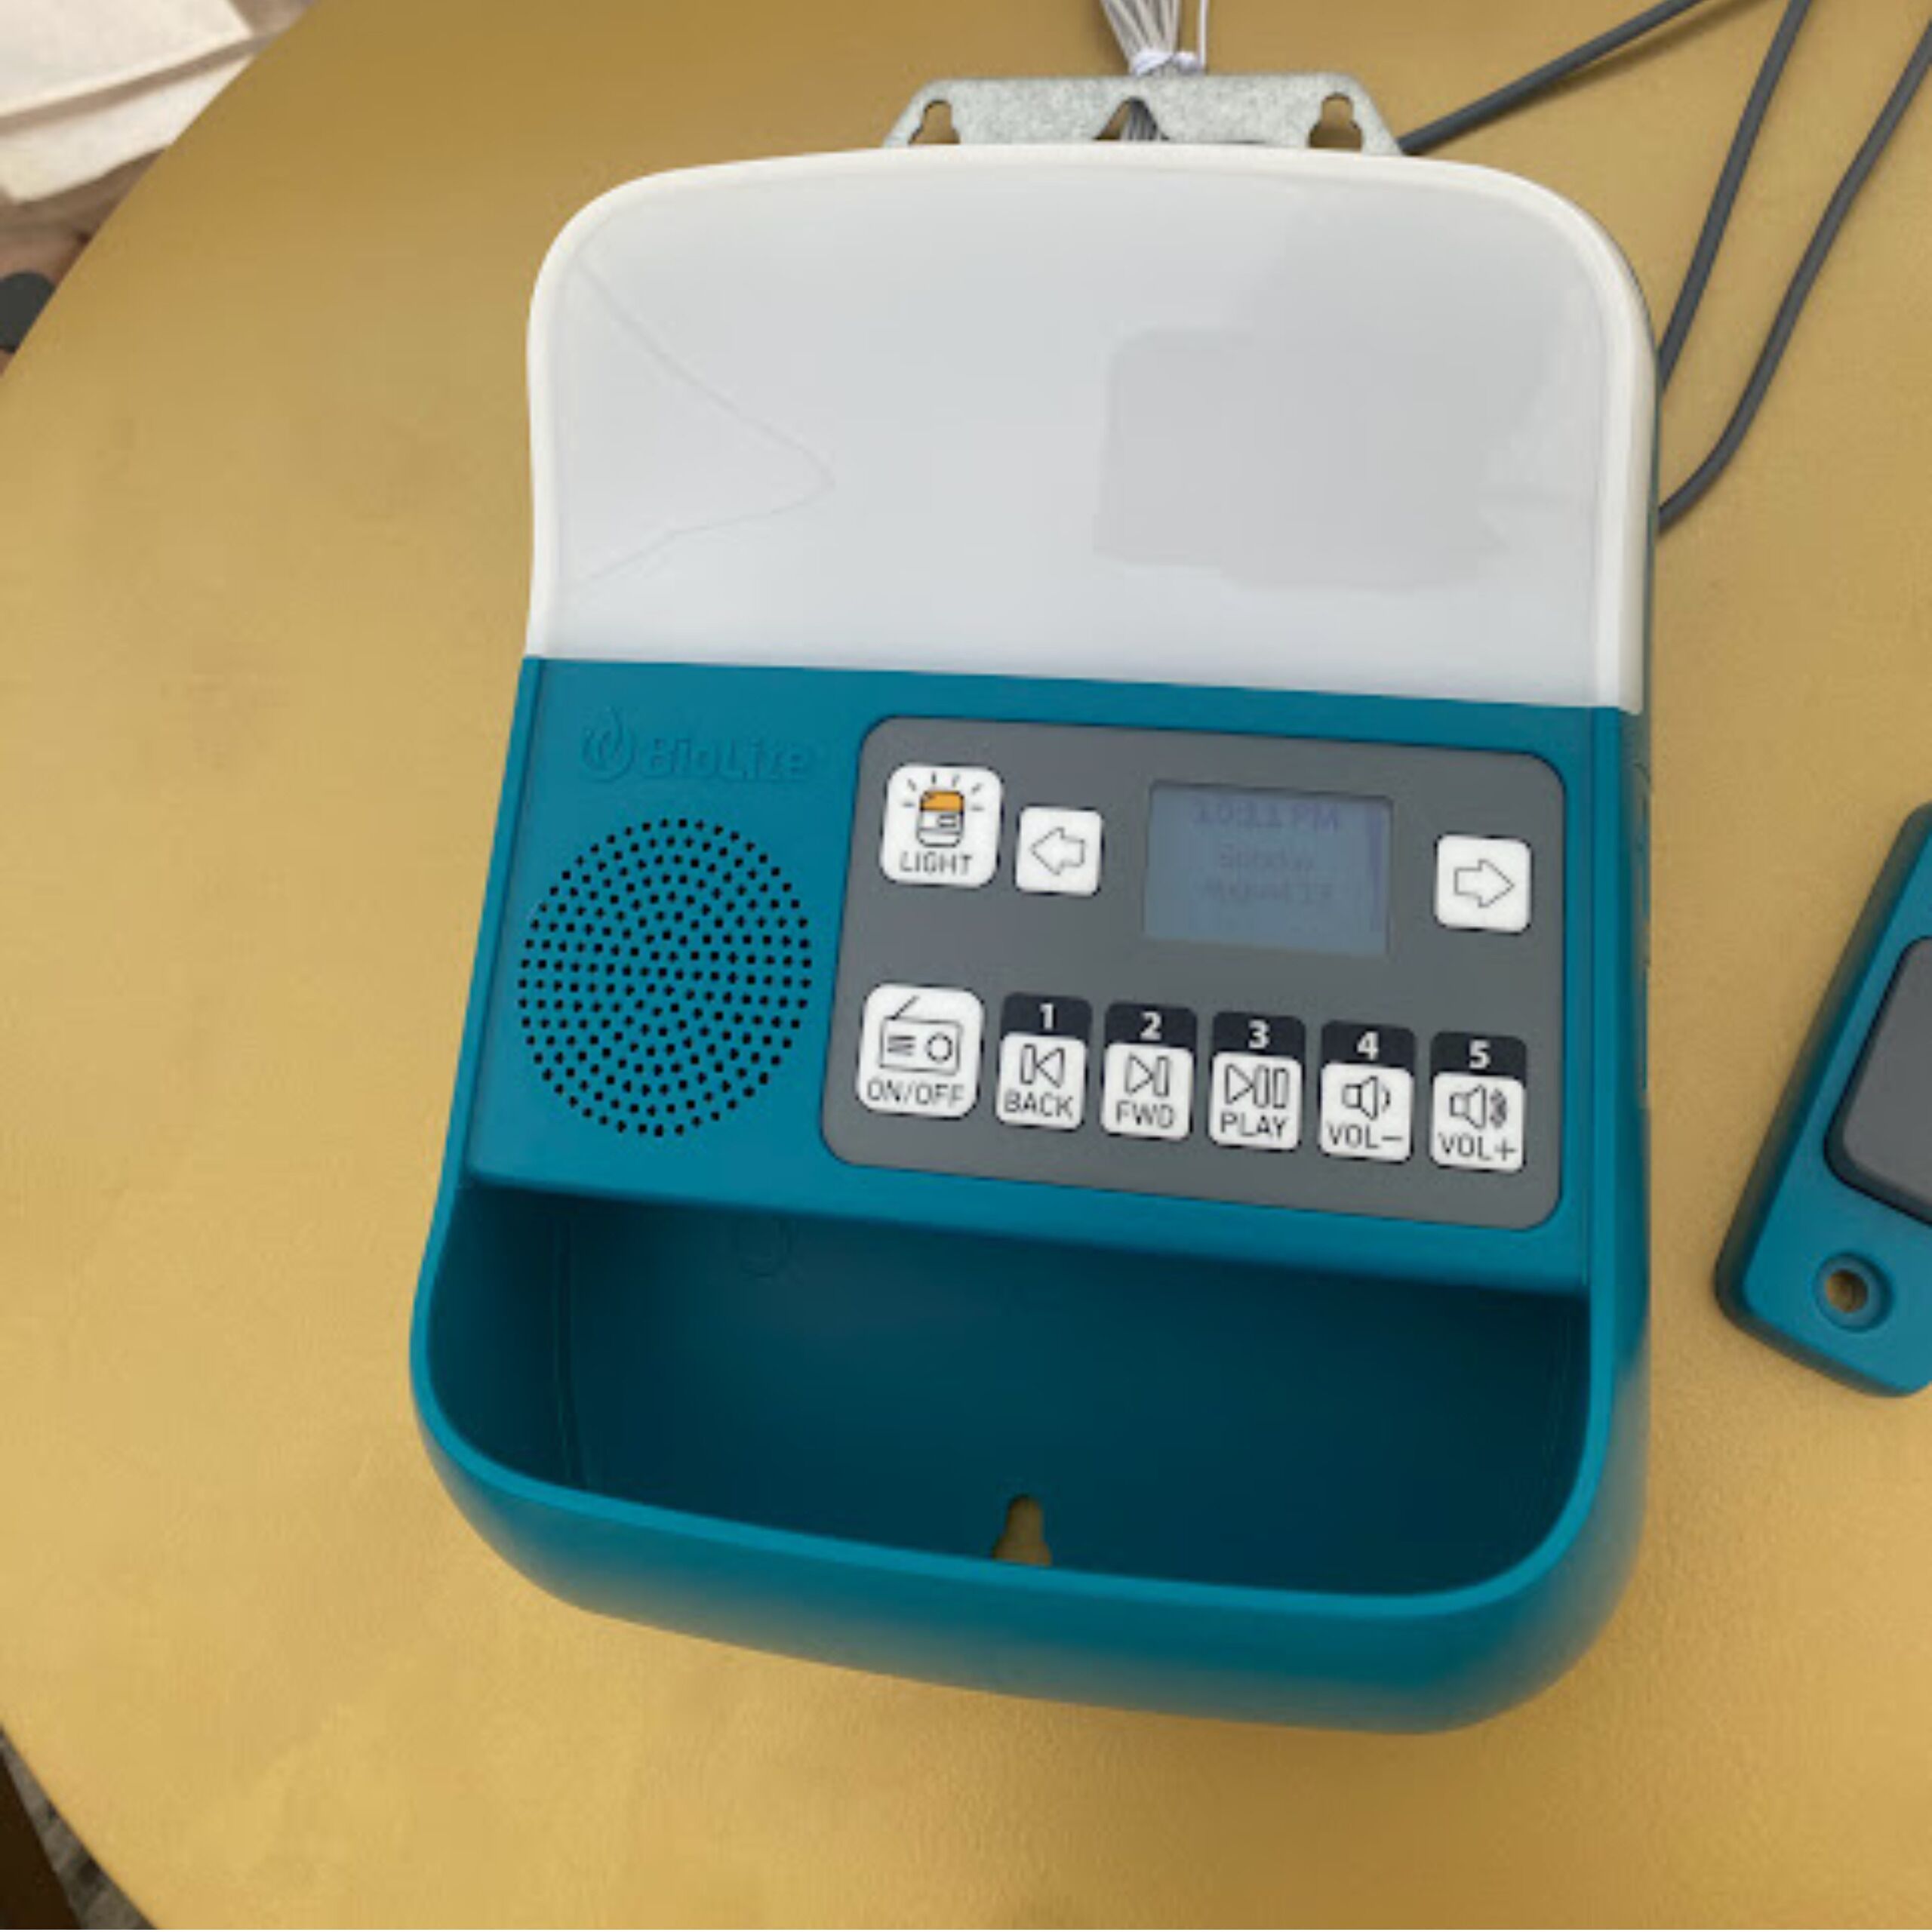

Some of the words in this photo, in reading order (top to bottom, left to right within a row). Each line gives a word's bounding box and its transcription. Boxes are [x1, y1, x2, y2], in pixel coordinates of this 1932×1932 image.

[1291, 802, 1340, 832] PM
[900, 851, 972, 877] LIGHT
[1040, 1003, 1054, 1029] 1
[1140, 1012, 1161, 1039] 2
[1249, 1020, 1269, 1048] 3
[1358, 1032, 1379, 1060] 4
[1470, 1040, 1490, 1069] 5
[867, 1078, 965, 1109] ON/OFF
[1004, 1091, 1073, 1119] BACK
[1115, 1100, 1174, 1130] FWD
[1220, 1112, 1287, 1138] PLAY
[1438, 1134, 1517, 1162] VOL+
